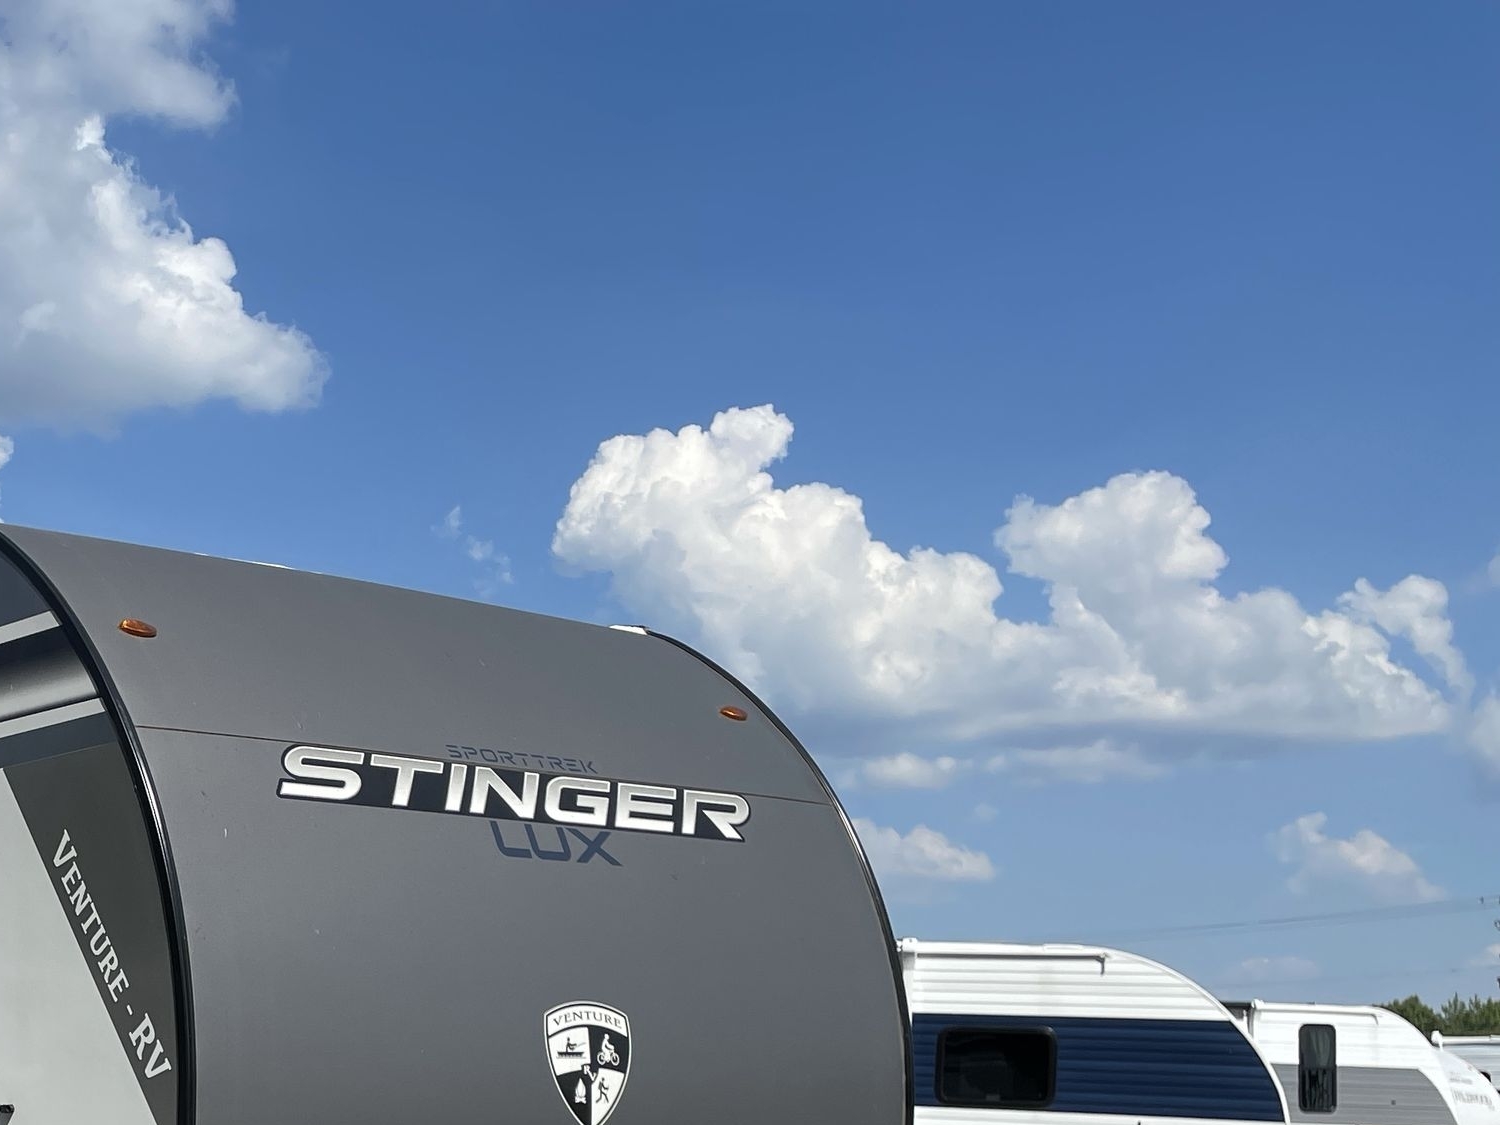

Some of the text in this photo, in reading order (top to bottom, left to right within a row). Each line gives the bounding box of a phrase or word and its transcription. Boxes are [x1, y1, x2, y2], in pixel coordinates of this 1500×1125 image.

[445, 744, 599, 775] SPORTTREK
[277, 743, 751, 841] STINGER
[489, 820, 623, 867] LUX
[52, 828, 130, 1003] VENTURE
[128, 1013, 173, 1080] RV
[553, 1010, 622, 1029] VENTURE
